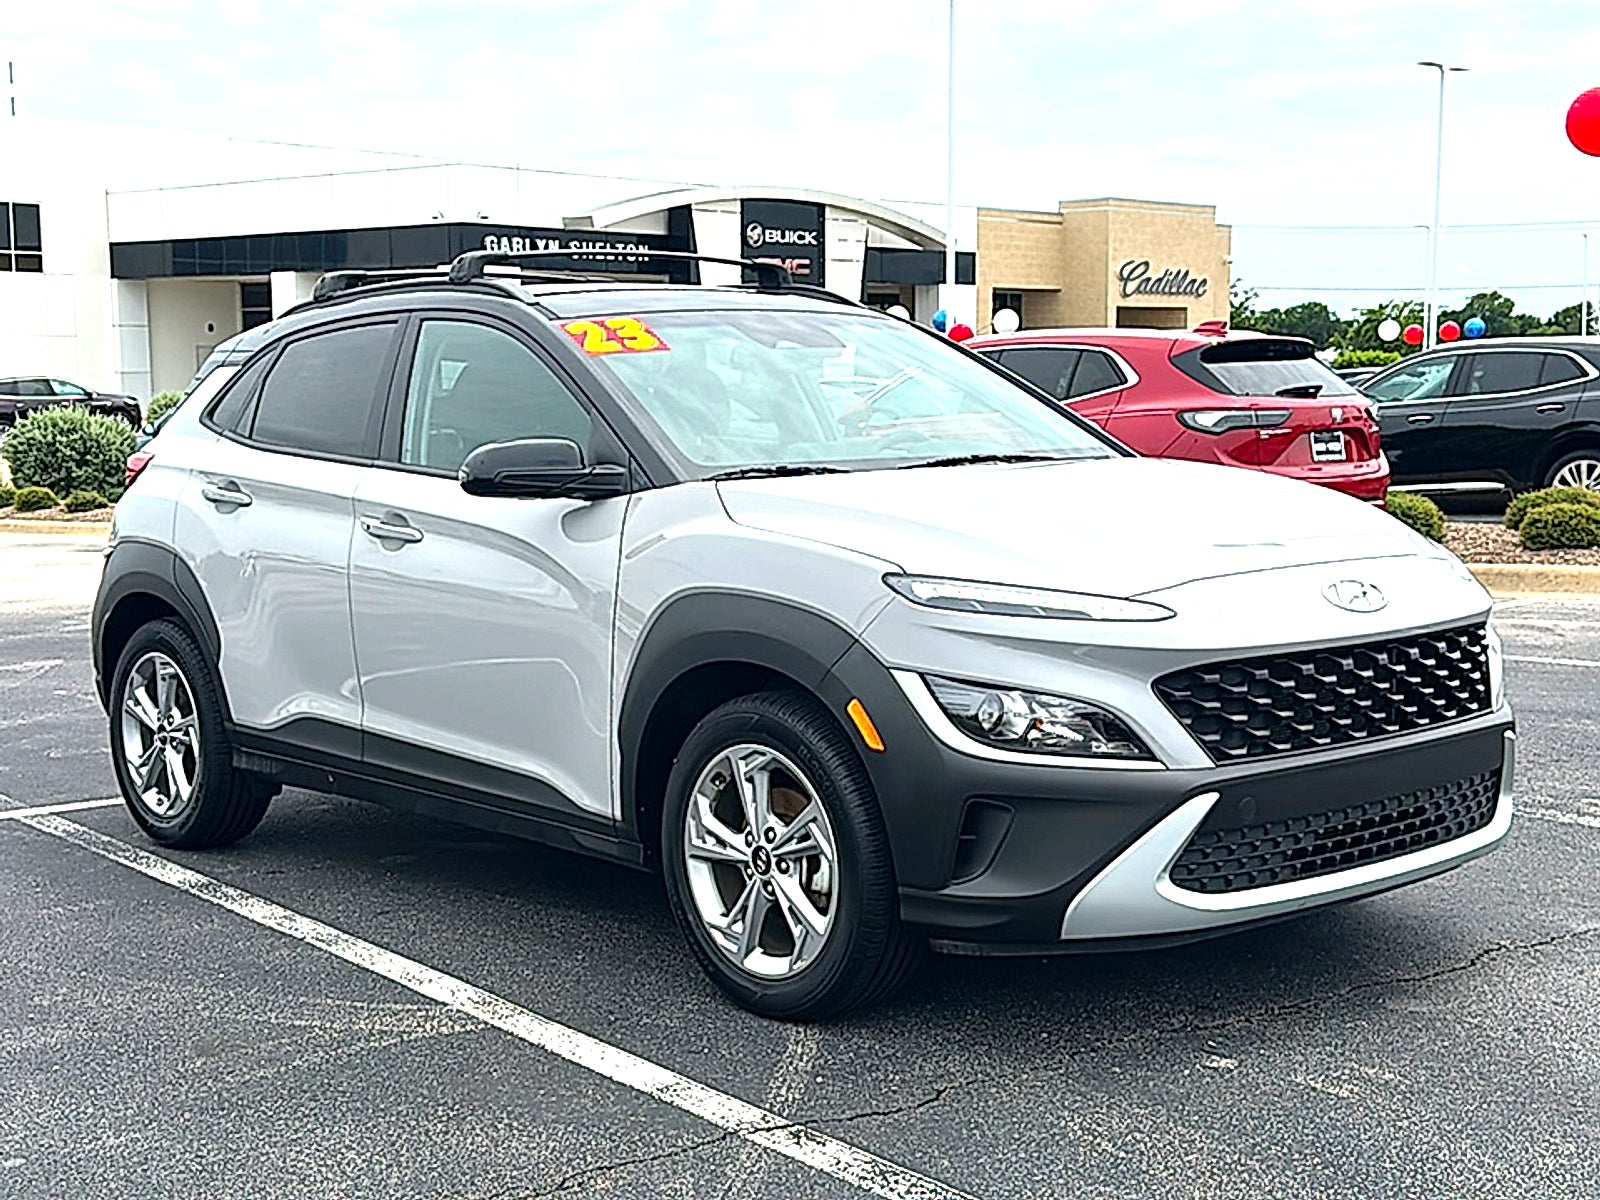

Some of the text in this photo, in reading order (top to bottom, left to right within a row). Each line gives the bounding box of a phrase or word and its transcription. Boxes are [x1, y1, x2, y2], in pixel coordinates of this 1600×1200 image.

[764, 229, 818, 245] BUICK
[1118, 260, 1208, 298] Cadillac
[563, 318, 661, 352] 23
